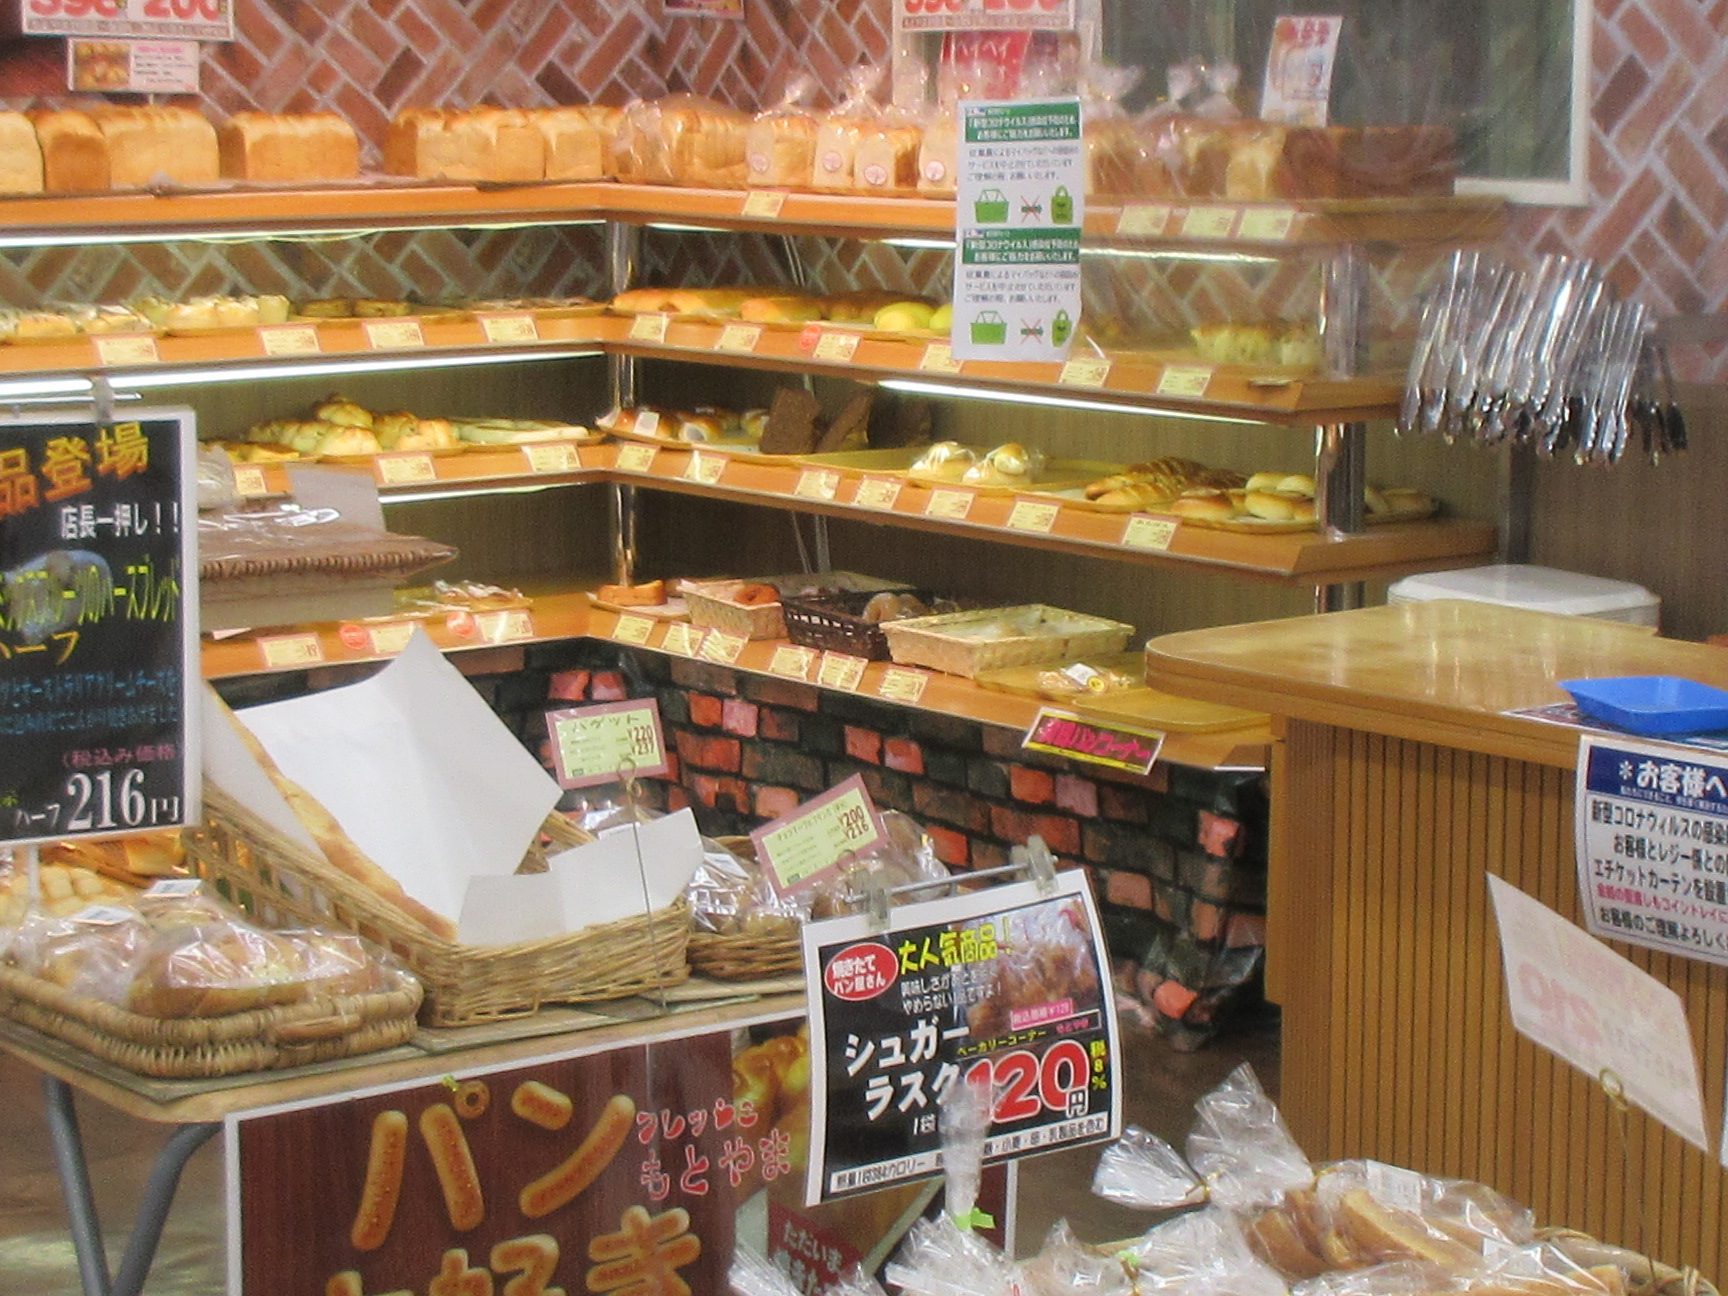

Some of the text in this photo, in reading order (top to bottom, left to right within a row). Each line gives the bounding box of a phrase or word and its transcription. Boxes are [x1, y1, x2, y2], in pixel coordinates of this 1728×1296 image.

[67, 768, 145, 831] 216
[1637, 760, 1728, 799] お客様へ
[837, 805, 865, 827] ¥200
[843, 819, 869, 840] ¥216
[898, 916, 1013, 975] 大人気商品！
[845, 1016, 971, 1078] シュガー
[865, 1061, 960, 1122] ラスク
[965, 1039, 1090, 1123] 120
[351, 1078, 636, 1251] パン
[640, 1127, 791, 1201] もとやま
